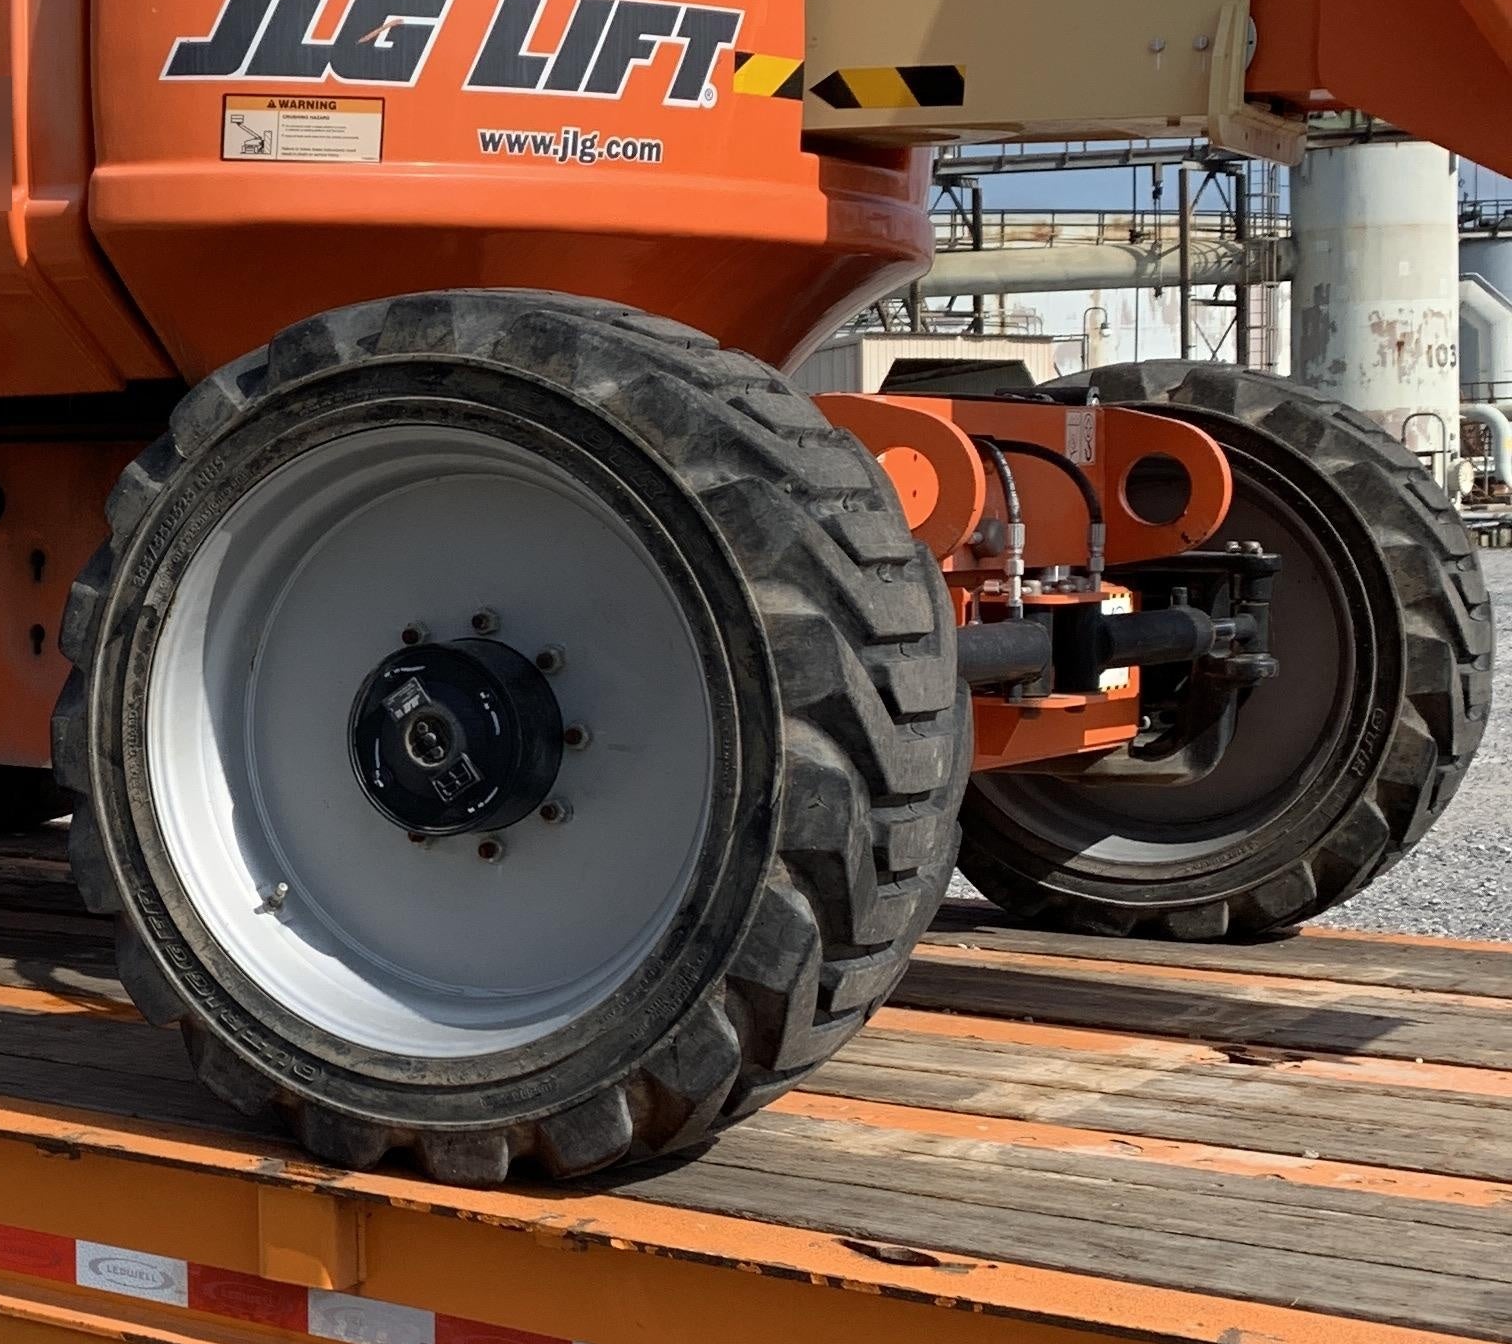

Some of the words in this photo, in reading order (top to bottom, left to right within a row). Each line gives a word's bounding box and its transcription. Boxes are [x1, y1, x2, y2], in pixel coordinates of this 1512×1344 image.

[278, 99, 337, 111] WARNING
[478, 128, 662, 163] www.jlg.com
[106, 1263, 158, 1283] LEDWELL
